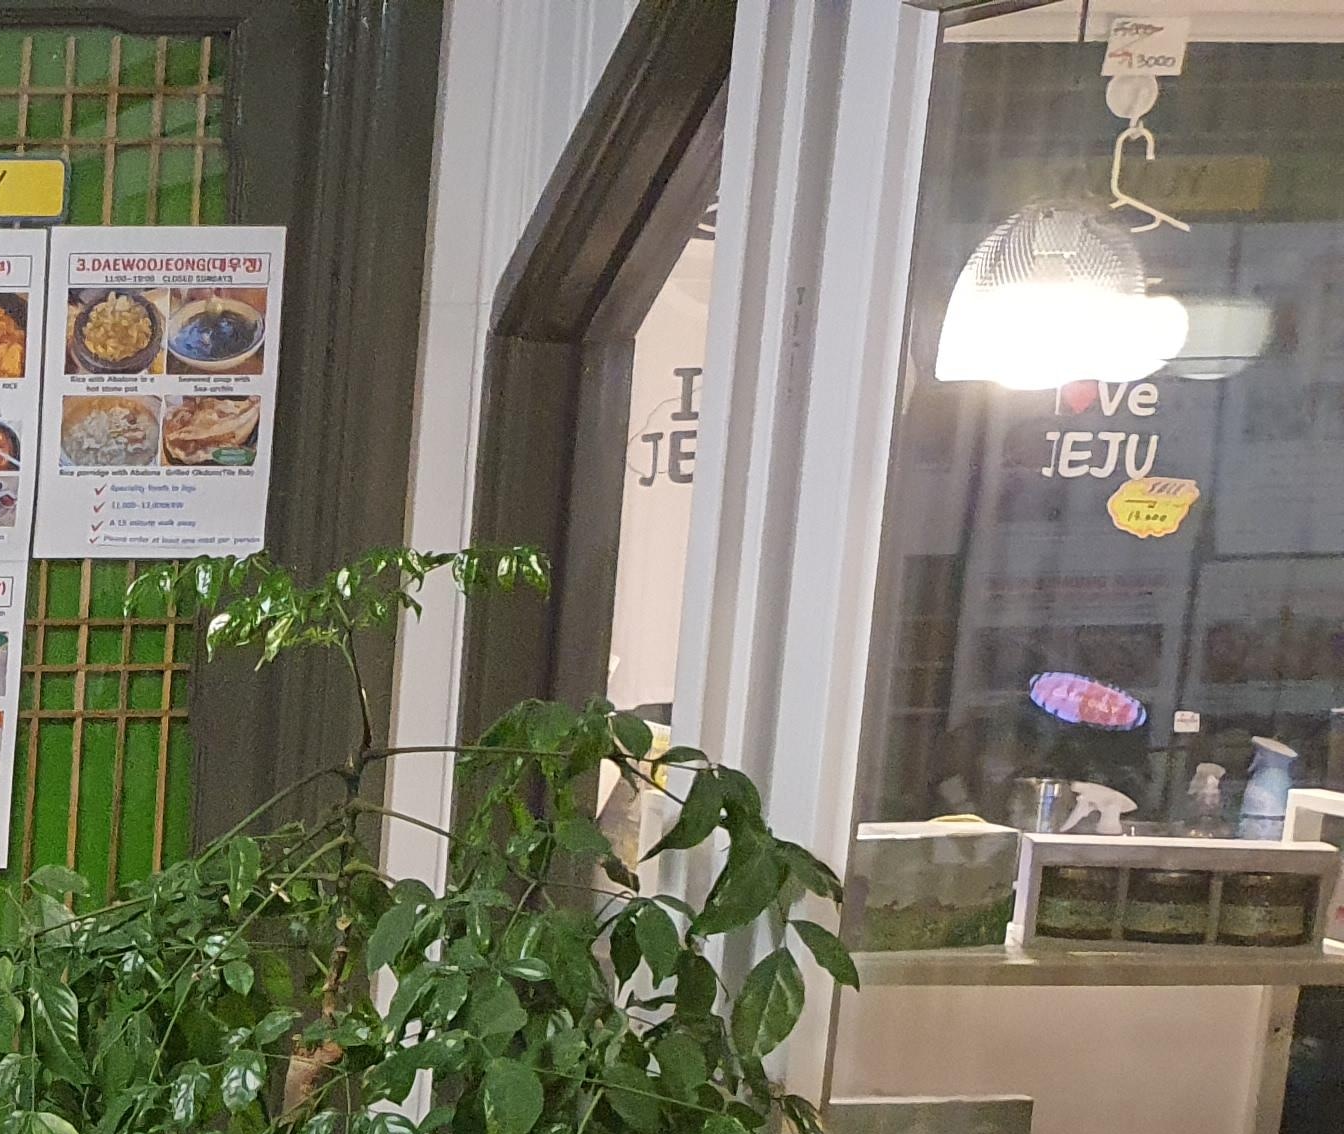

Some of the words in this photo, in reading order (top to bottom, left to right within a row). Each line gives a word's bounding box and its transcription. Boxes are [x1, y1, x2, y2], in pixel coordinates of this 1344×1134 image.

[671, 368, 702, 421] I
[639, 430, 697, 486] JE
[1042, 431, 1159, 480] JEJU
